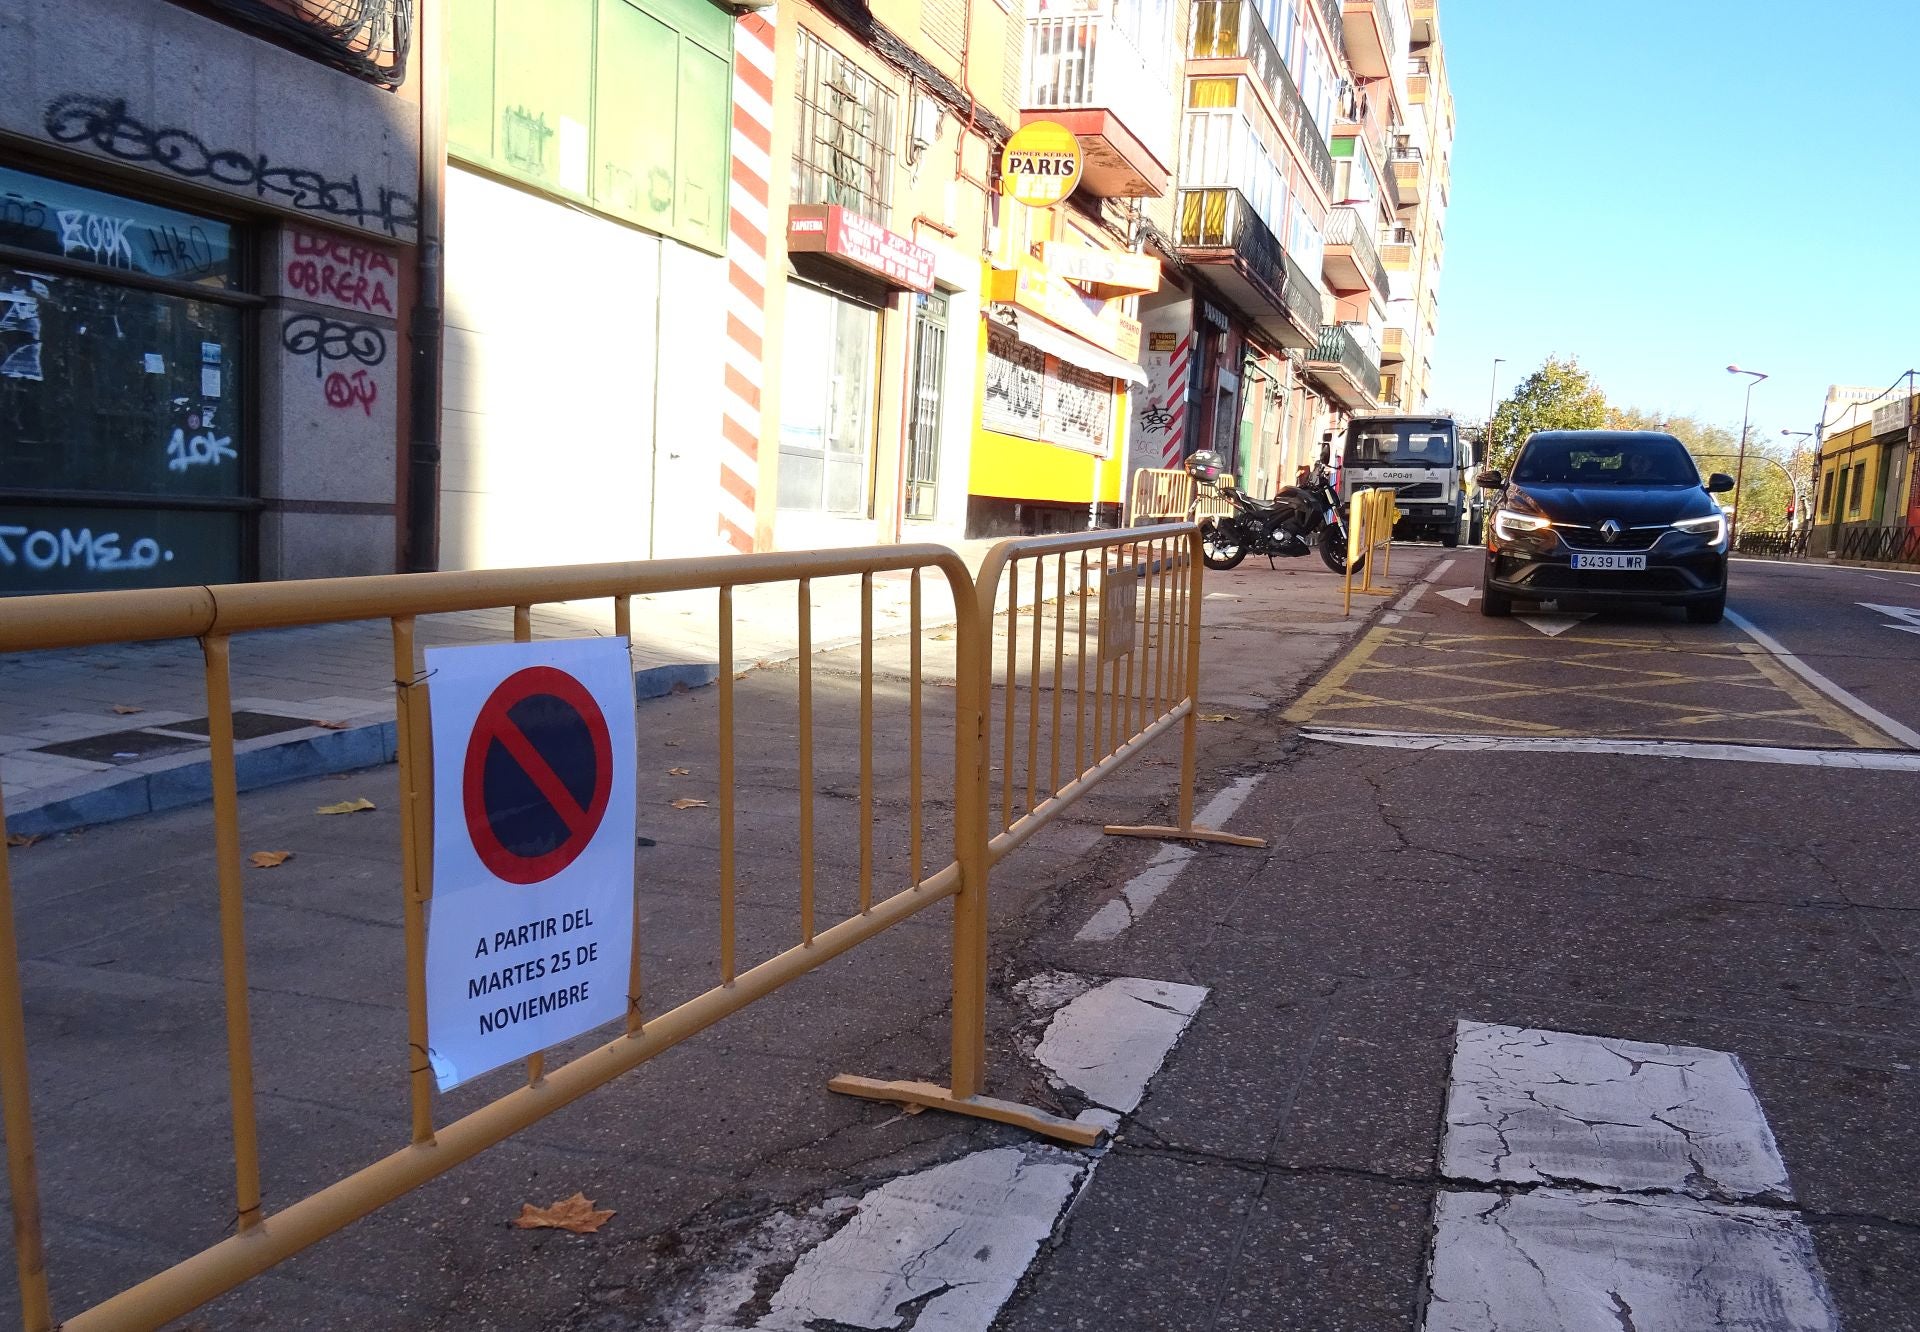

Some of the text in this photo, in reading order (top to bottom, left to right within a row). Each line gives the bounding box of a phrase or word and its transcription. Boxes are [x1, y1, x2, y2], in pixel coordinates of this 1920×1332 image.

[1008, 158, 1074, 176] PARIS
[294, 231, 394, 277] LUCHA
[288, 261, 392, 312] OBRERA
[1120, 319, 1140, 335] HORARIO
[1580, 556, 1642, 568] 3439 LWR
[475, 908, 593, 958] A PARTIR DEL
[468, 942, 598, 999] MARTES 25 DE
[479, 981, 590, 1035] NOVIEMBRE
